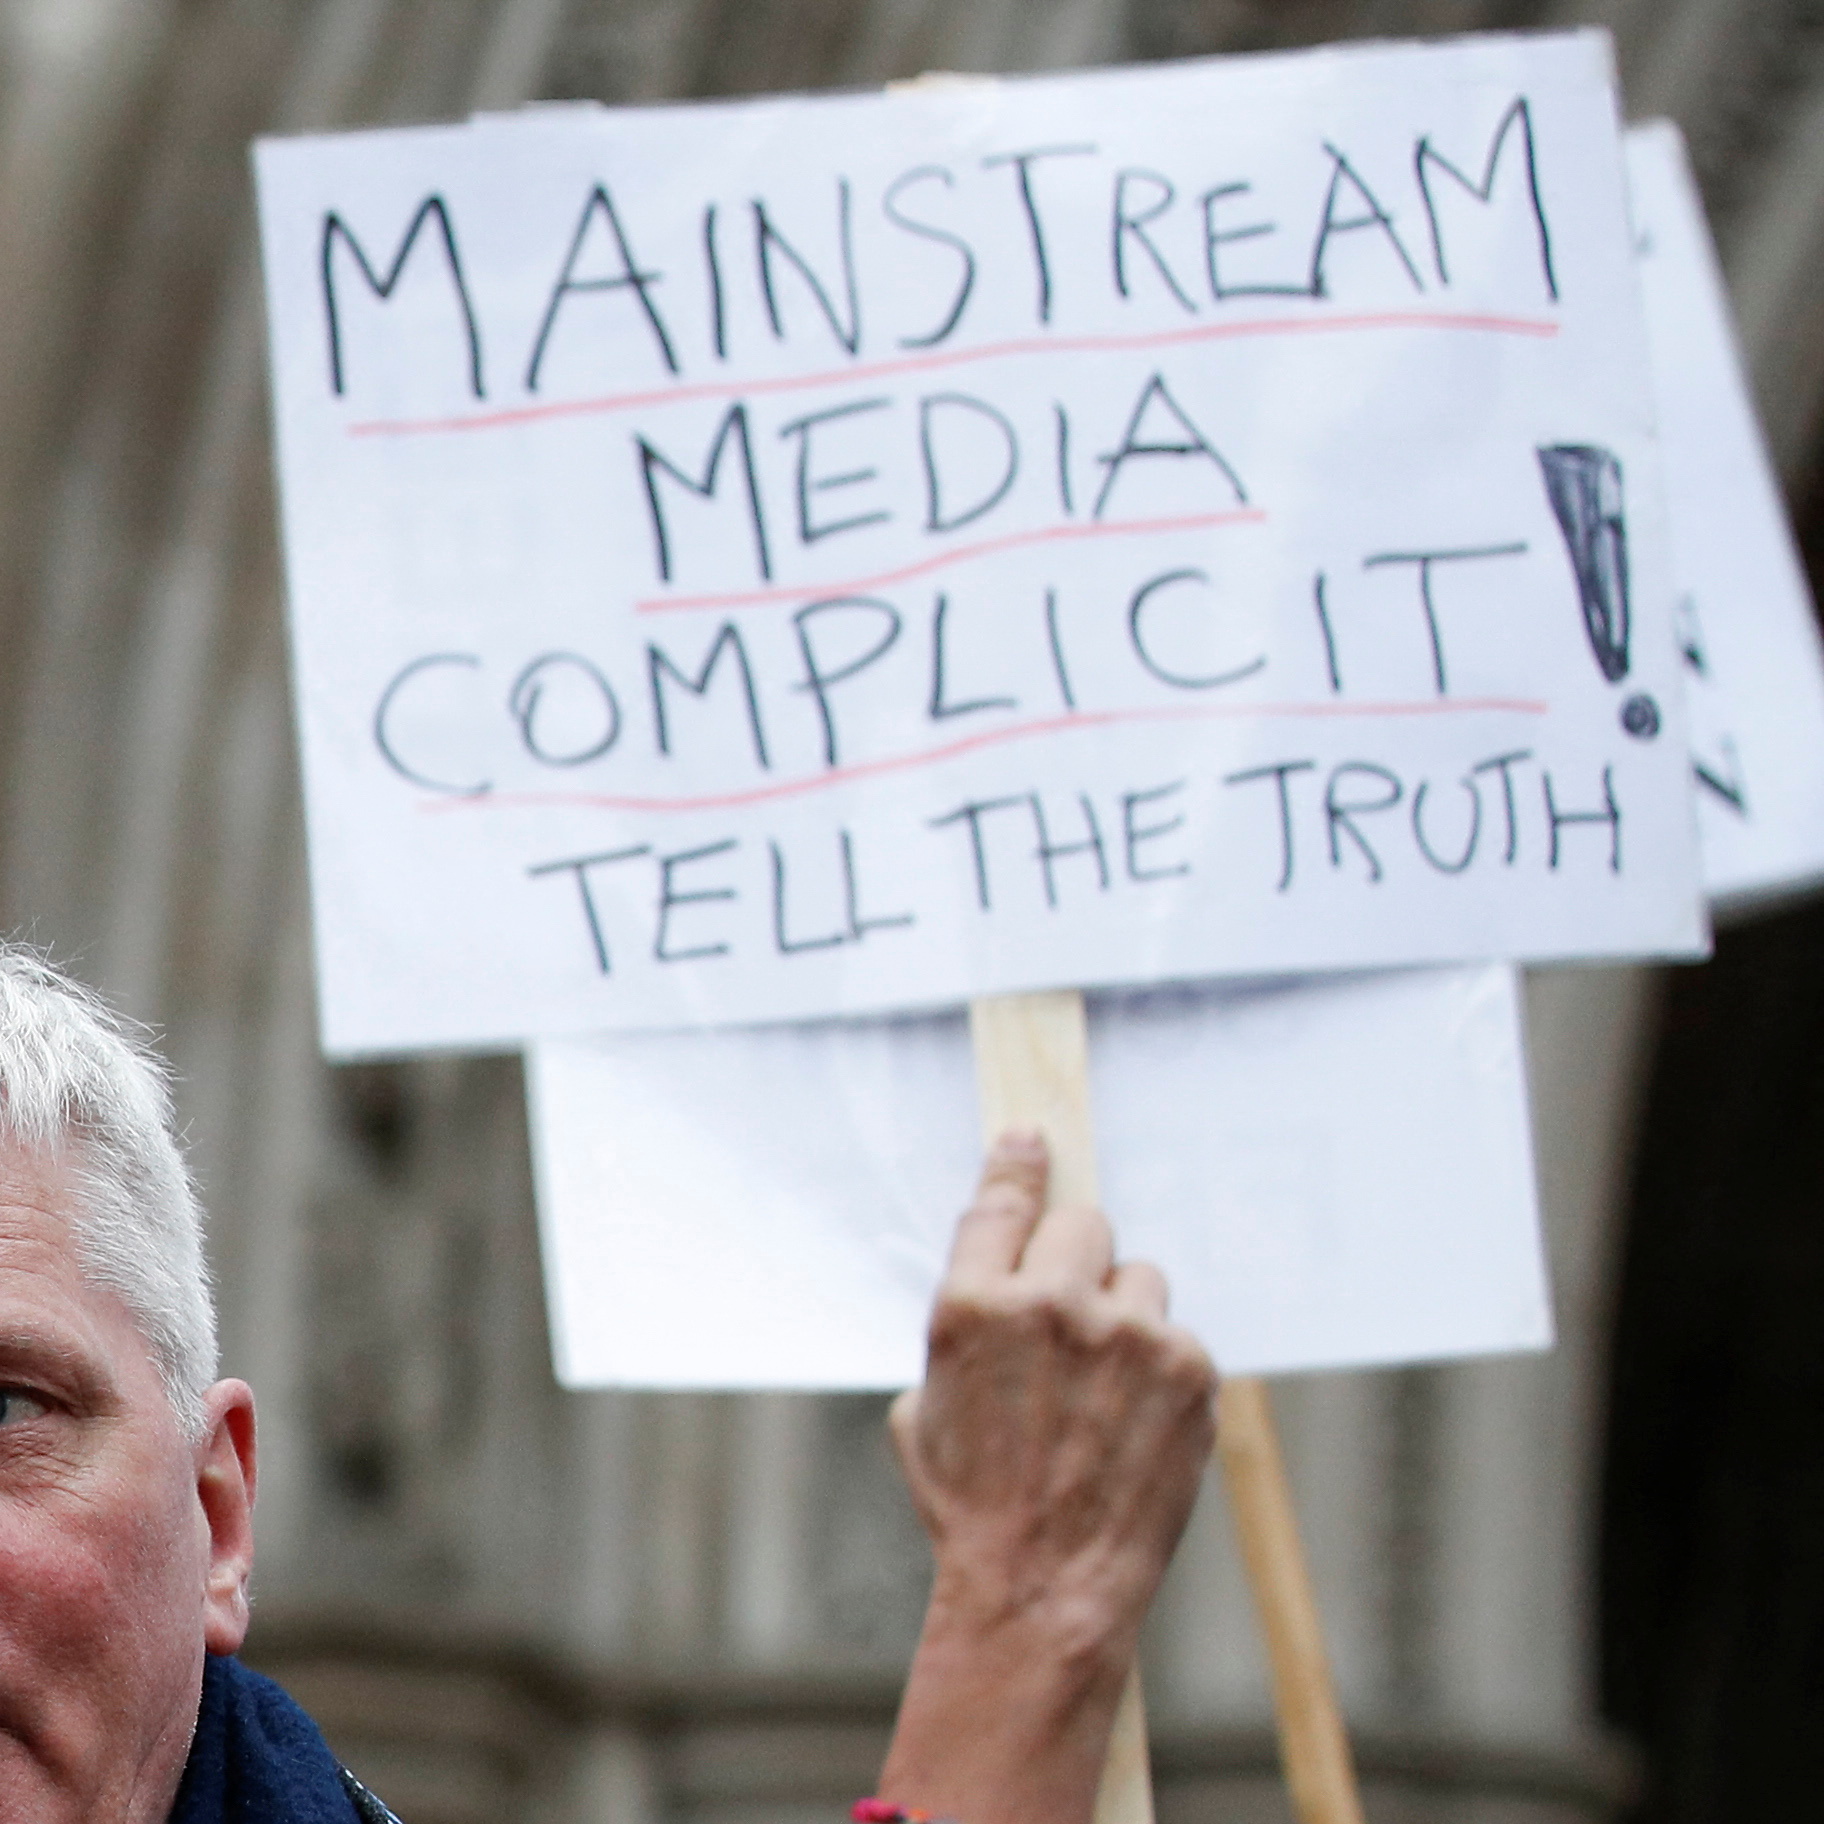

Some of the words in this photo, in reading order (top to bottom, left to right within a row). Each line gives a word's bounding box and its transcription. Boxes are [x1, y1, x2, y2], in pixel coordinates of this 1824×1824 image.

[319, 95, 1562, 400] MAINSTREAM
[634, 375, 1251, 587] MEDIA
[527, 832, 913, 977] TELL
[927, 782, 1192, 910] THE
[1226, 750, 1622, 891] TRUTH
